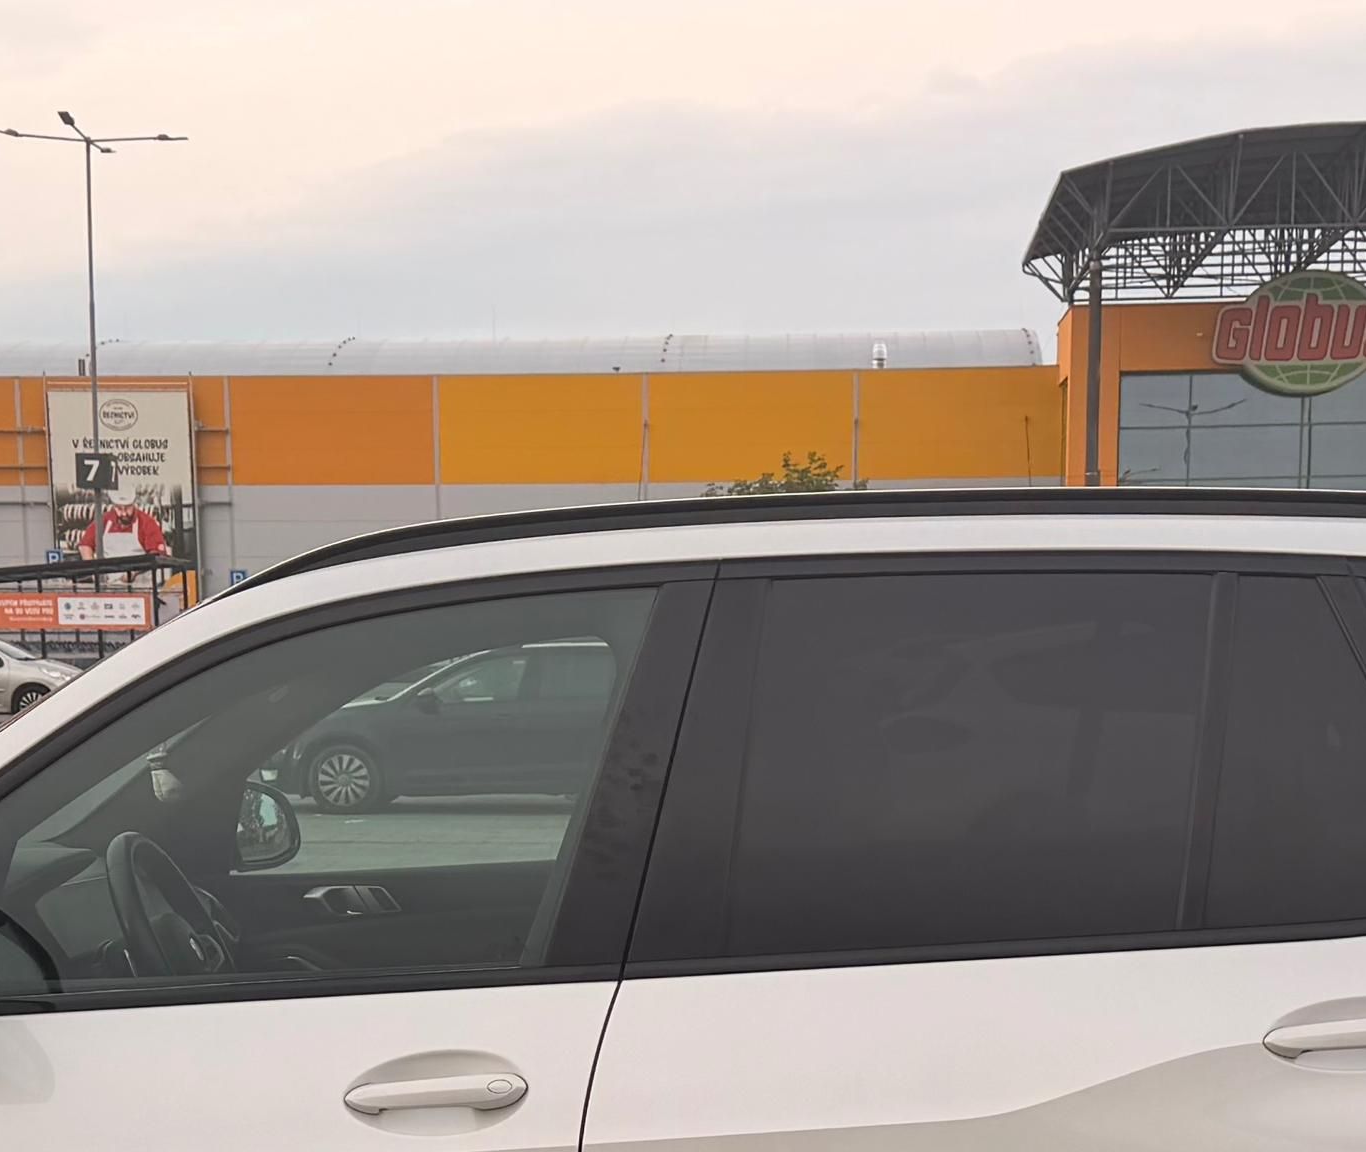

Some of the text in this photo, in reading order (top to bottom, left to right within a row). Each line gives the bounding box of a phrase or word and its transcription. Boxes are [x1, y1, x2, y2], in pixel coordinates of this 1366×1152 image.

[72, 436, 169, 449] V ŘENICTVÍ GLOBUS
[83, 459, 100, 481] 7
